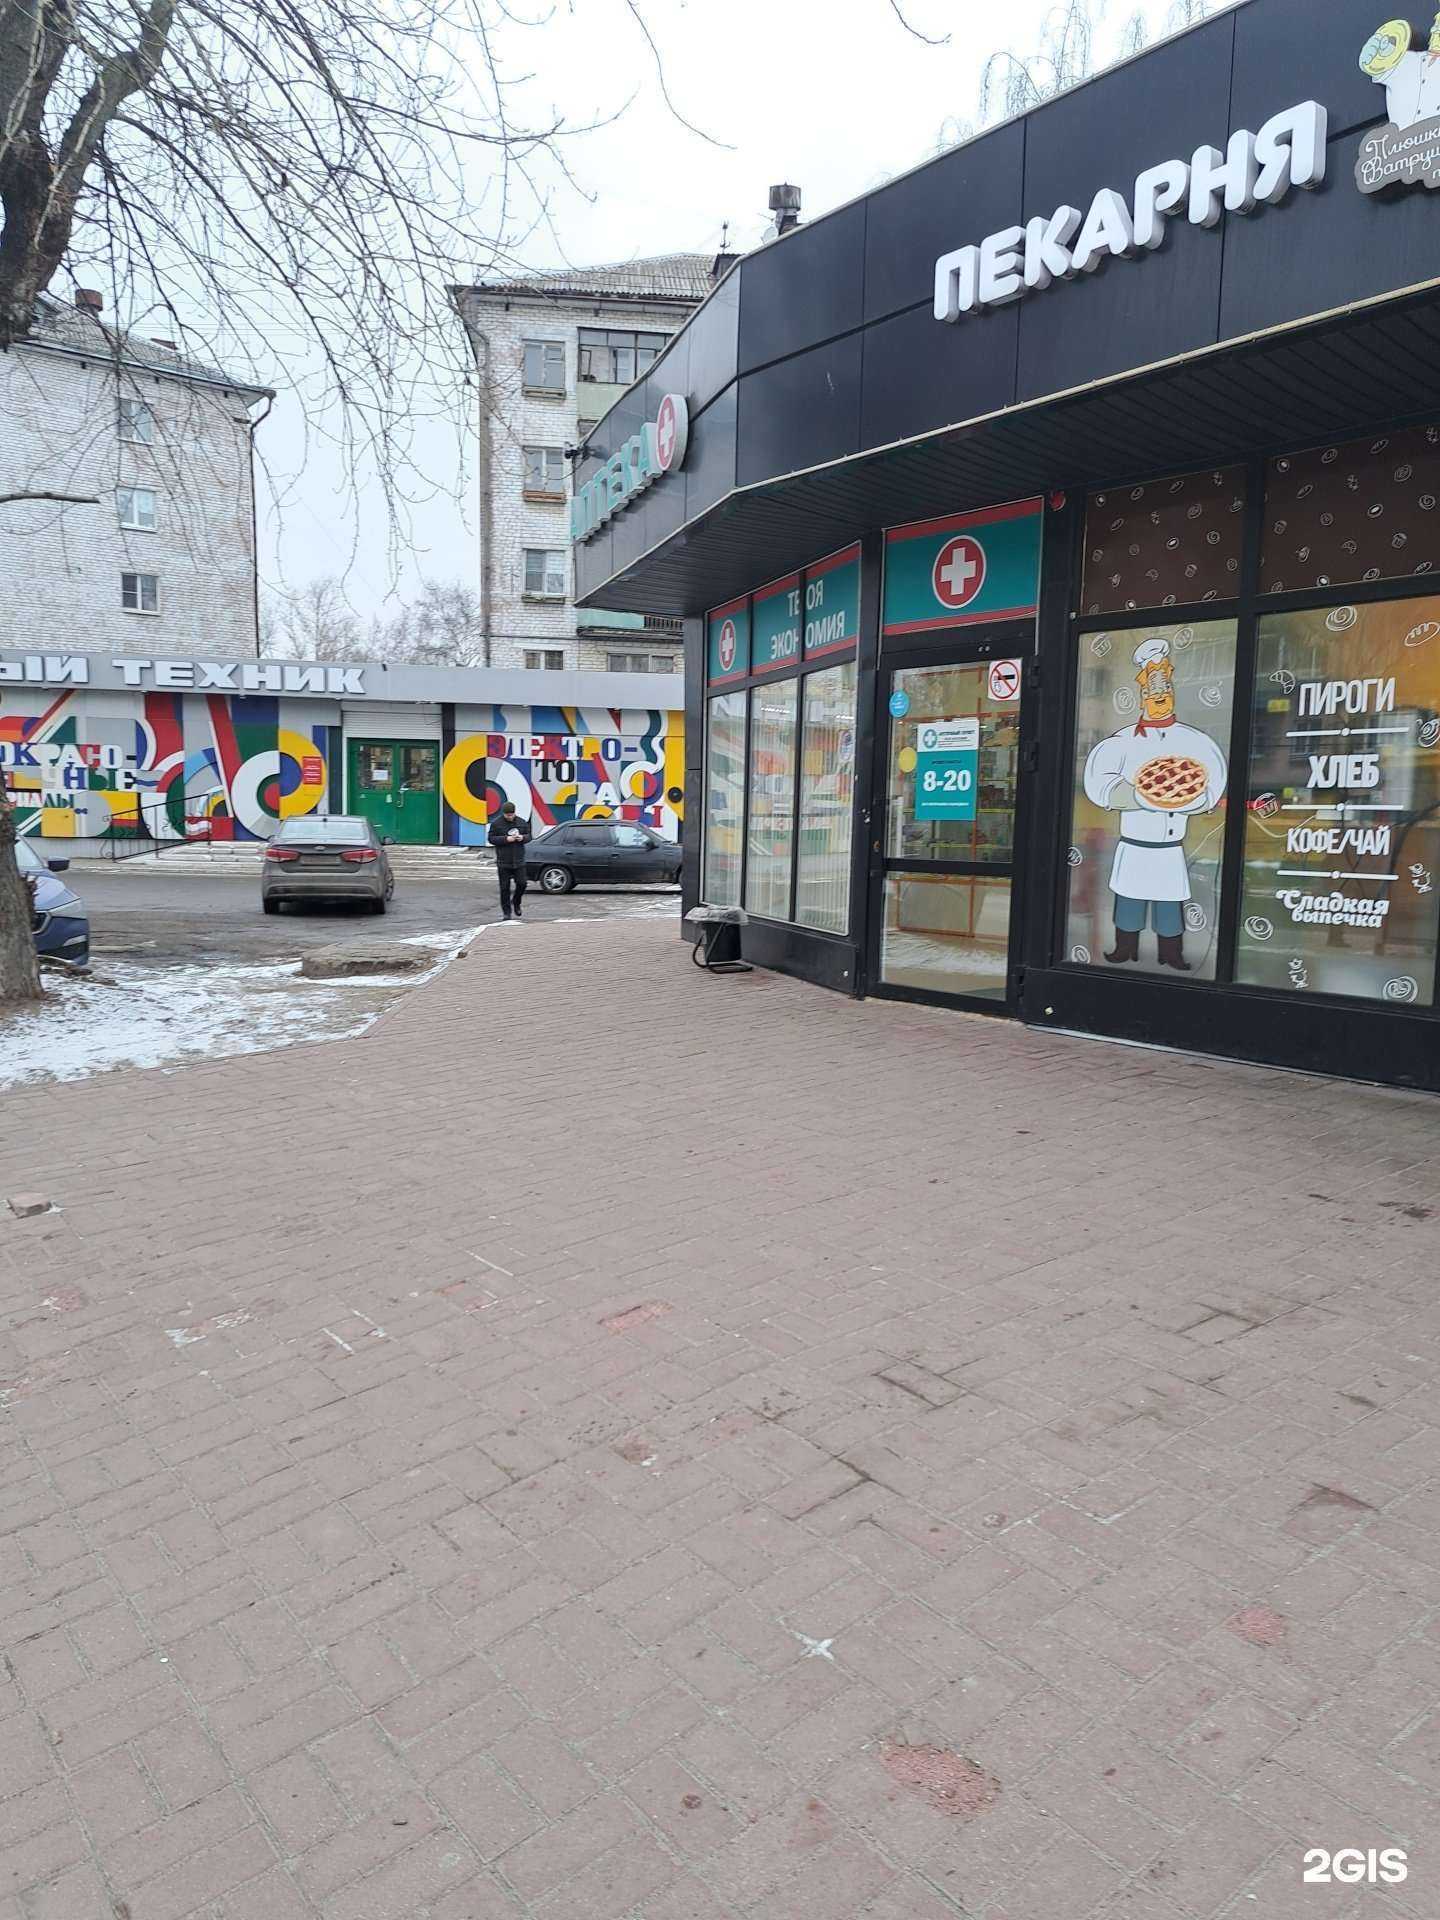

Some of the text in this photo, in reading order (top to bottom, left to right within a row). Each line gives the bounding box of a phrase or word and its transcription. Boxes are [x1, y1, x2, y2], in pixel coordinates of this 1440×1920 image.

[1365, 127, 1440, 160] Плюшк
[933, 100, 1328, 323] ПЕКАРНЯ
[112, 659, 367, 695] ТЕХНИК
[1297, 677, 1396, 716] ПИРОГИ
[923, 769, 972, 792] 8-20
[1306, 753, 1380, 789] ХЛЕБ
[1286, 825, 1391, 856] КОФЕ/ЧАЙ
[1275, 889, 1390, 915] Сладкая
[1291, 905, 1383, 928] выпечка
